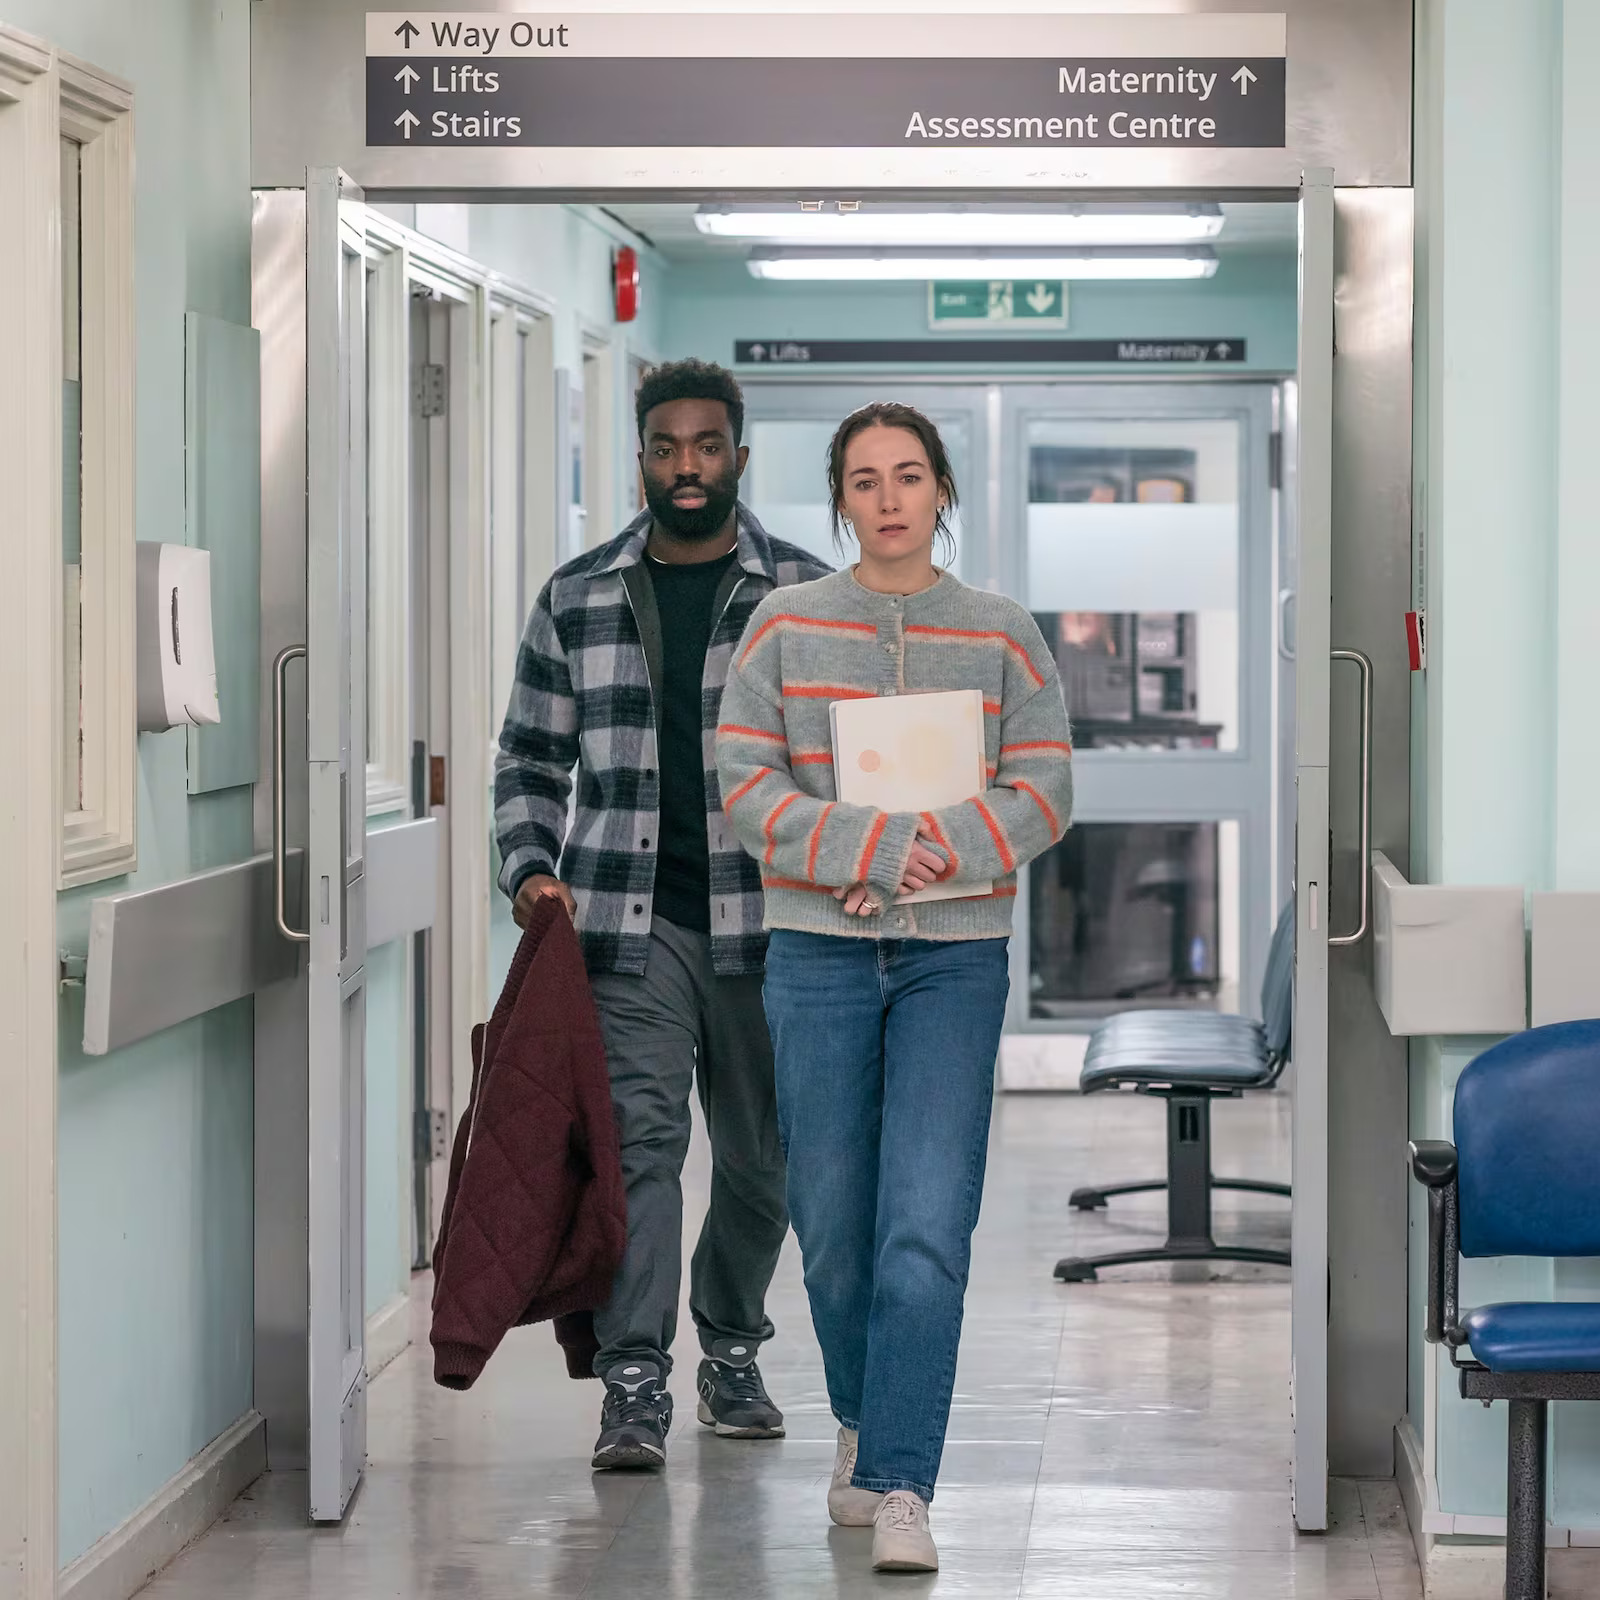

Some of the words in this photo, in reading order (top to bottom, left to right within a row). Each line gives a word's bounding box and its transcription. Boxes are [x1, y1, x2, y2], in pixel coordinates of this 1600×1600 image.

[431, 22, 500, 54] Way
[509, 22, 569, 48] Out
[432, 65, 500, 93] Lifts
[1058, 66, 1218, 101] Maternity
[431, 110, 522, 138] Stairs
[905, 111, 1099, 139] Assessment
[1108, 111, 1216, 139] Centre
[770, 344, 810, 361] Lifts
[1117, 344, 1208, 362] Maternity
